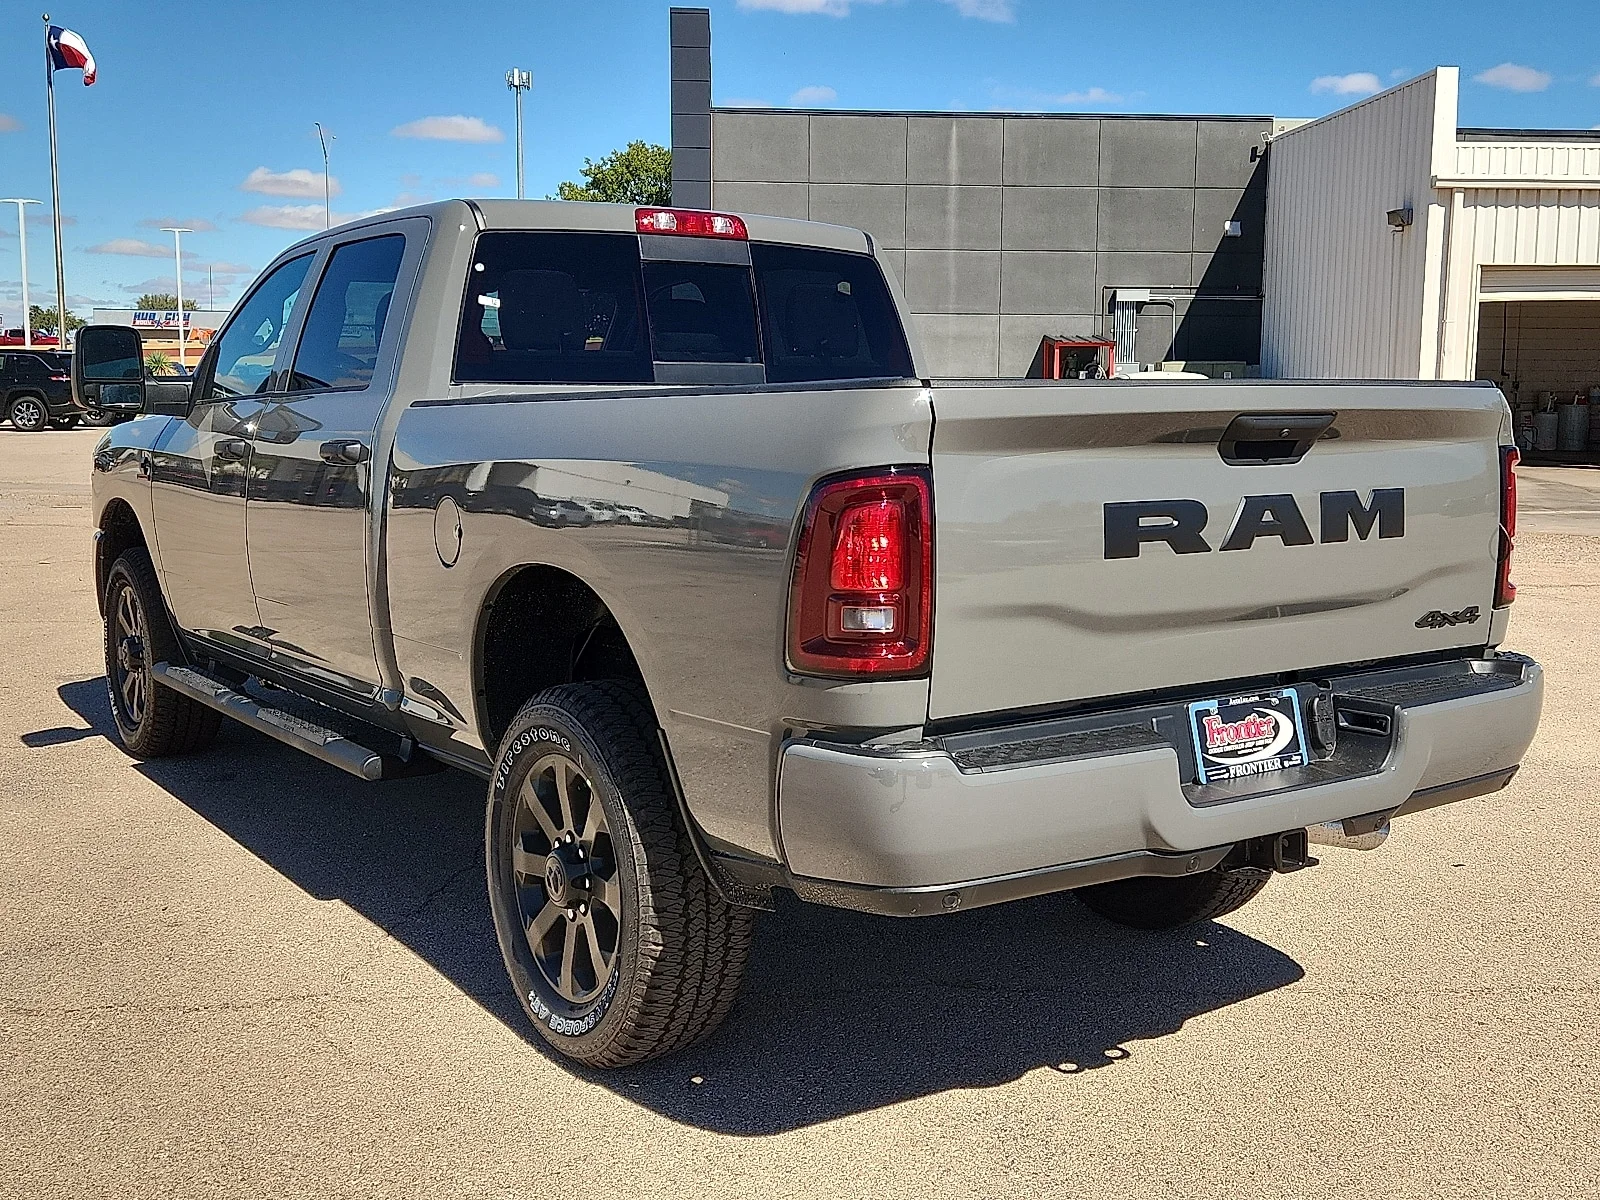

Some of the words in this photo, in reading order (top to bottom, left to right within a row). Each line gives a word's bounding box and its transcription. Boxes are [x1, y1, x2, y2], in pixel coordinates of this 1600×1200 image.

[1103, 487, 1406, 560] RAM
[496, 726, 571, 790] Firestone
[1204, 713, 1274, 747] Frontier
[1229, 757, 1282, 778] FRONTIER
[549, 968, 618, 1036] NSFORCE
